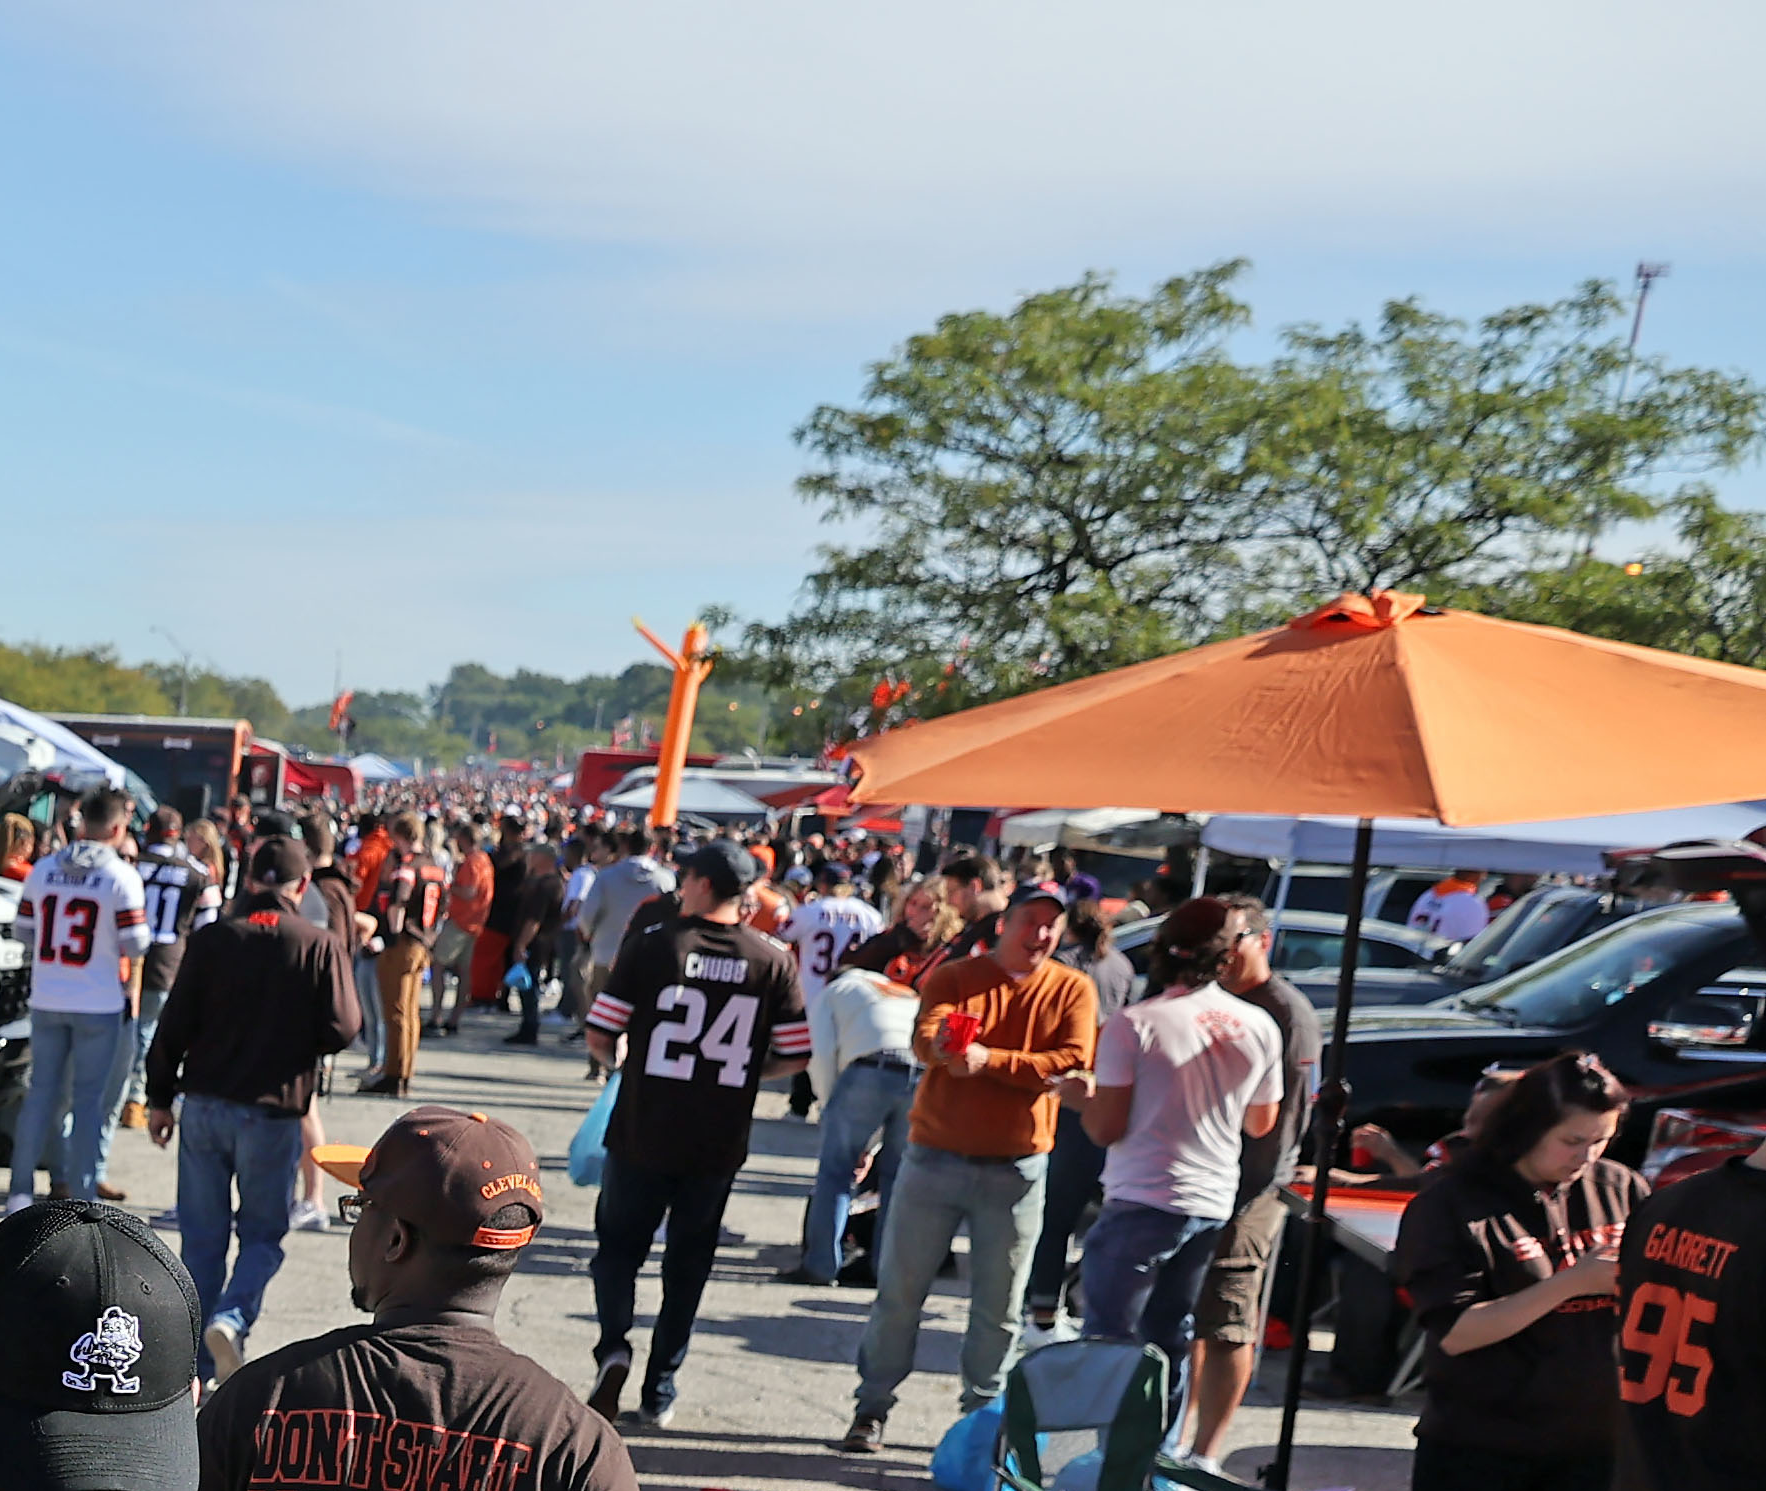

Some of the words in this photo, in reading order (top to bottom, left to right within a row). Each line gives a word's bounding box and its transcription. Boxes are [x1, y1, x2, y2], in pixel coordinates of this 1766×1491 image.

[39, 894, 100, 967] 13
[685, 952, 749, 984] CHUBB
[645, 985, 760, 1088] 24
[1644, 1222, 1740, 1280] GARRETT
[1620, 1281, 1718, 1418] 95
[250, 1408, 387, 1490] DON'T
